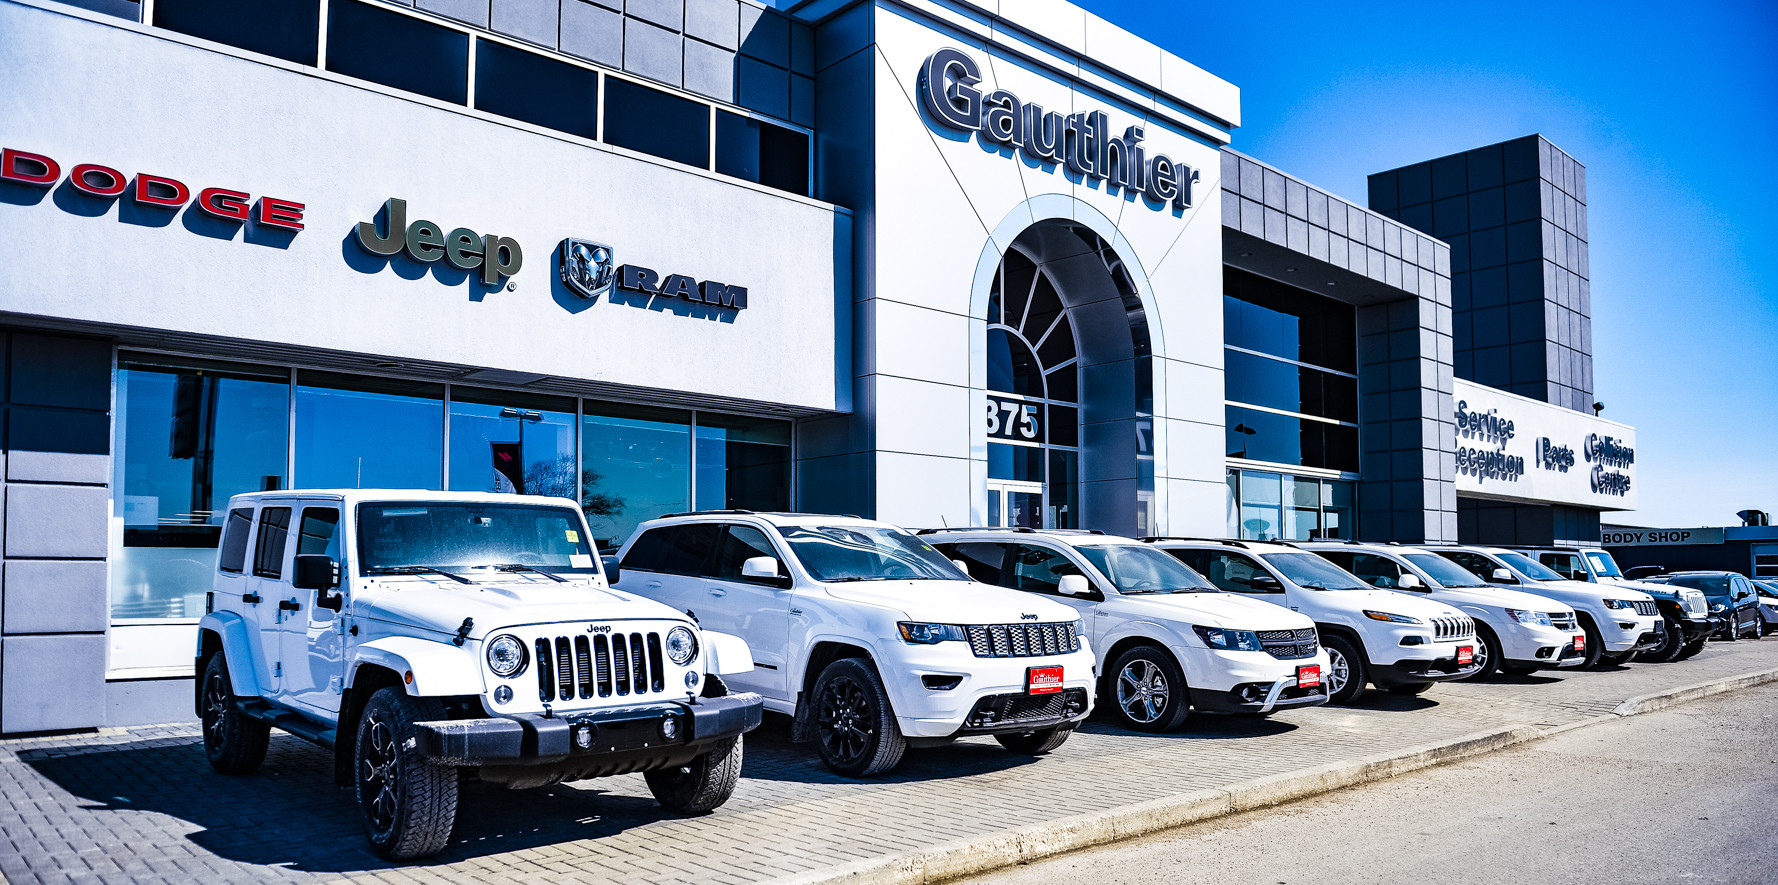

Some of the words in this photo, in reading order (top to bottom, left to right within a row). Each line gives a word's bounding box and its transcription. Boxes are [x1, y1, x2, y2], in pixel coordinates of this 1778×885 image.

[920, 47, 1200, 210] Gauthier
[1, 147, 305, 232] DODGE
[356, 197, 523, 286] Jeep
[616, 264, 748, 309] RAM
[987, 399, 1038, 438] 375
[1456, 400, 1515, 439] Service
[1455, 438, 1524, 477] eception
[1540, 437, 1574, 467] Parts
[1593, 464, 1631, 491] Centre
[1602, 532, 1644, 544] BODY
[1648, 531, 1691, 543] SHOP
[586, 623, 612, 634] Jeep
